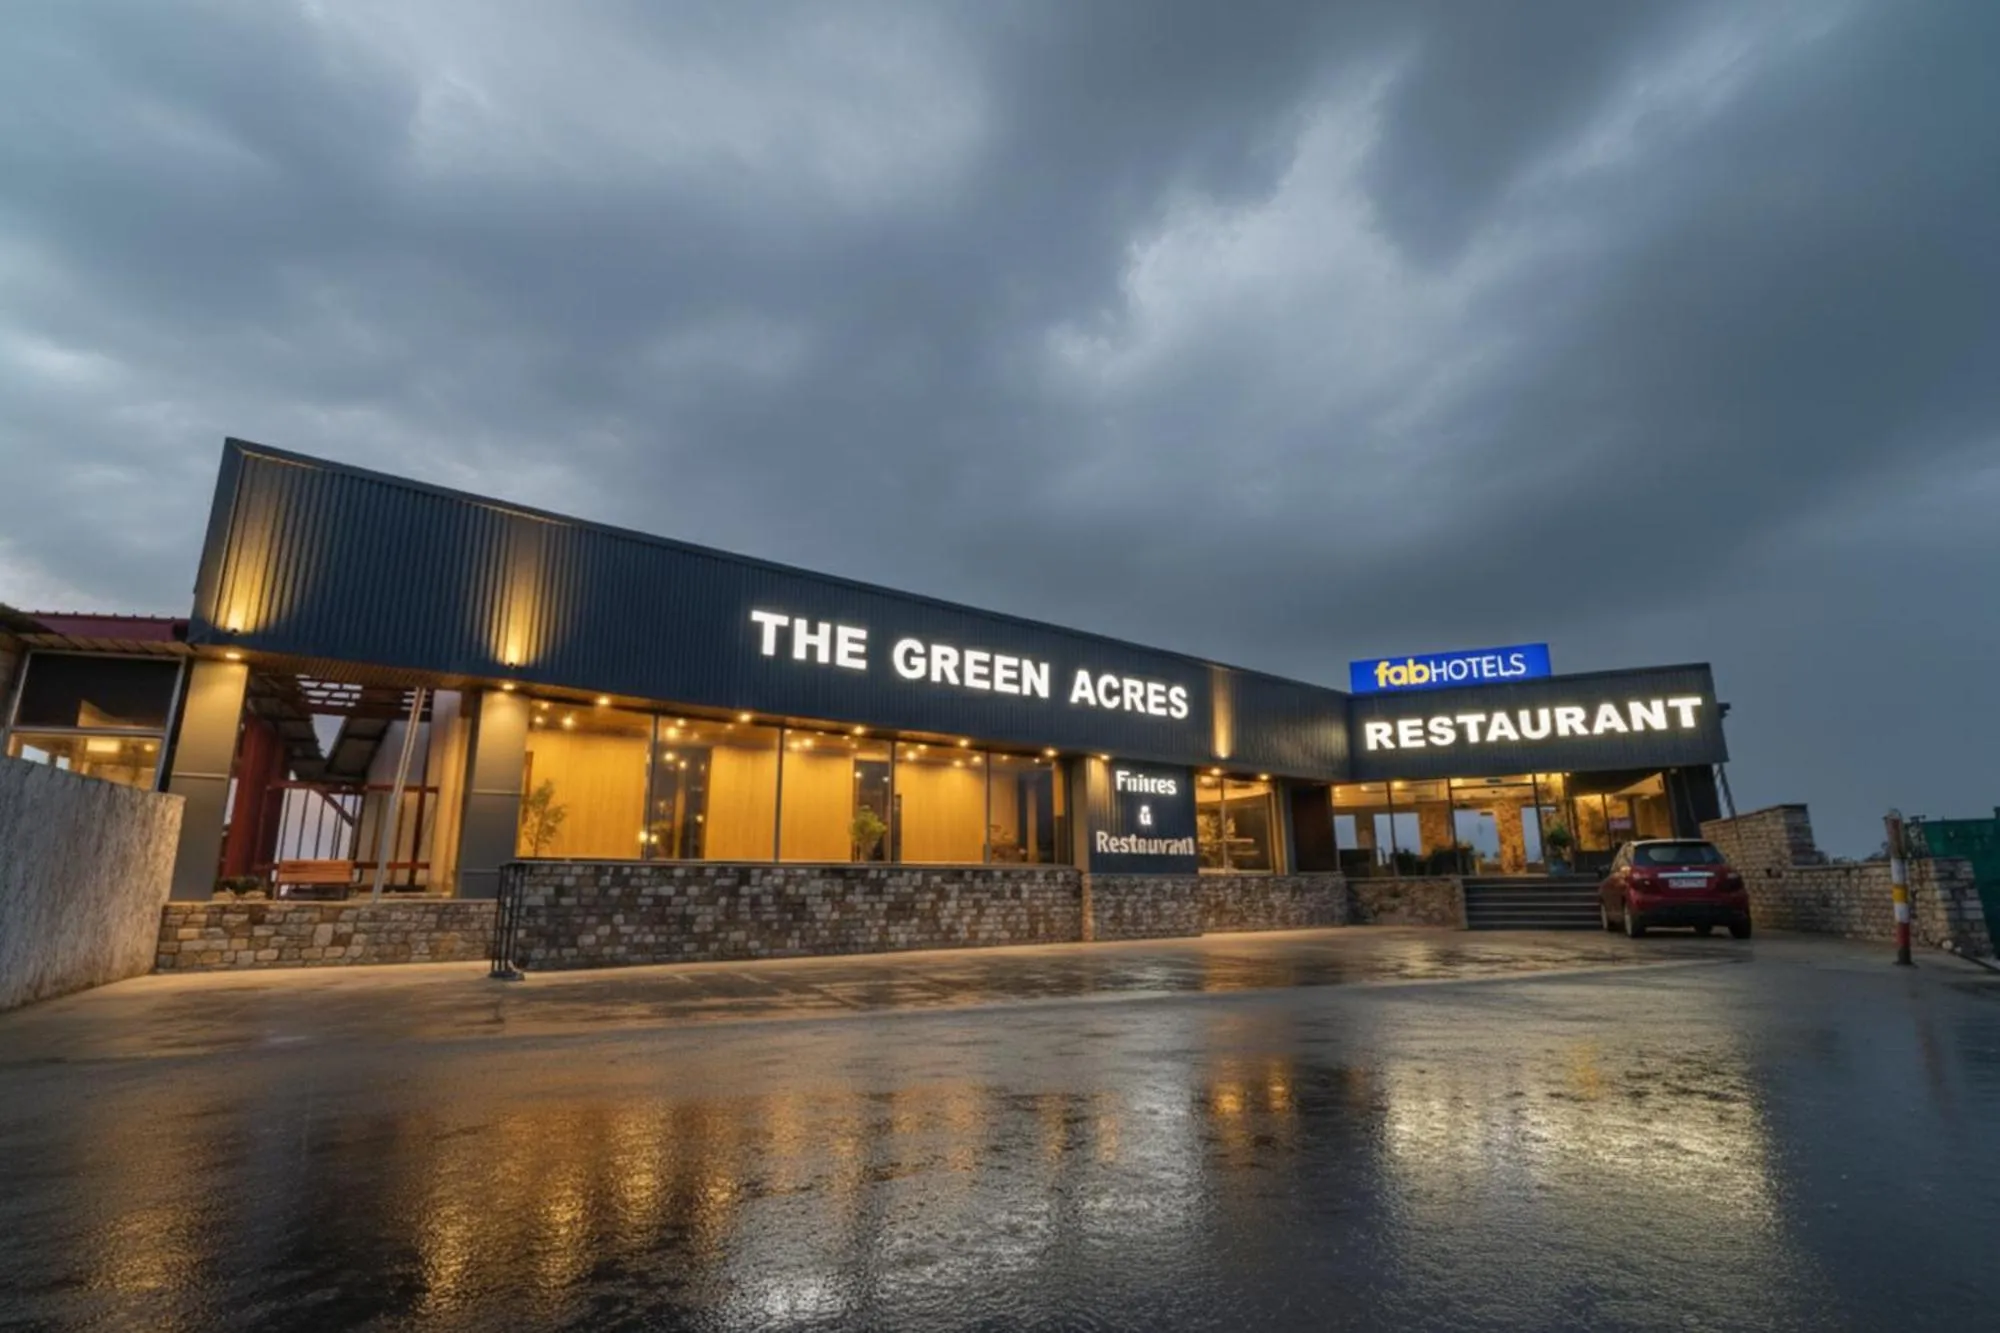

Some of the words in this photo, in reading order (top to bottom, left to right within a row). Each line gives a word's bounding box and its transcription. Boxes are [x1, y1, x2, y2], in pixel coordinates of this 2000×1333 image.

[751, 610, 868, 670] THE
[892, 637, 1051, 700] GREEN
[1069, 669, 1189, 719] ACRES
[1374, 653, 1527, 688] fabHOTELS
[1364, 696, 1702, 751] RESTAURANT
